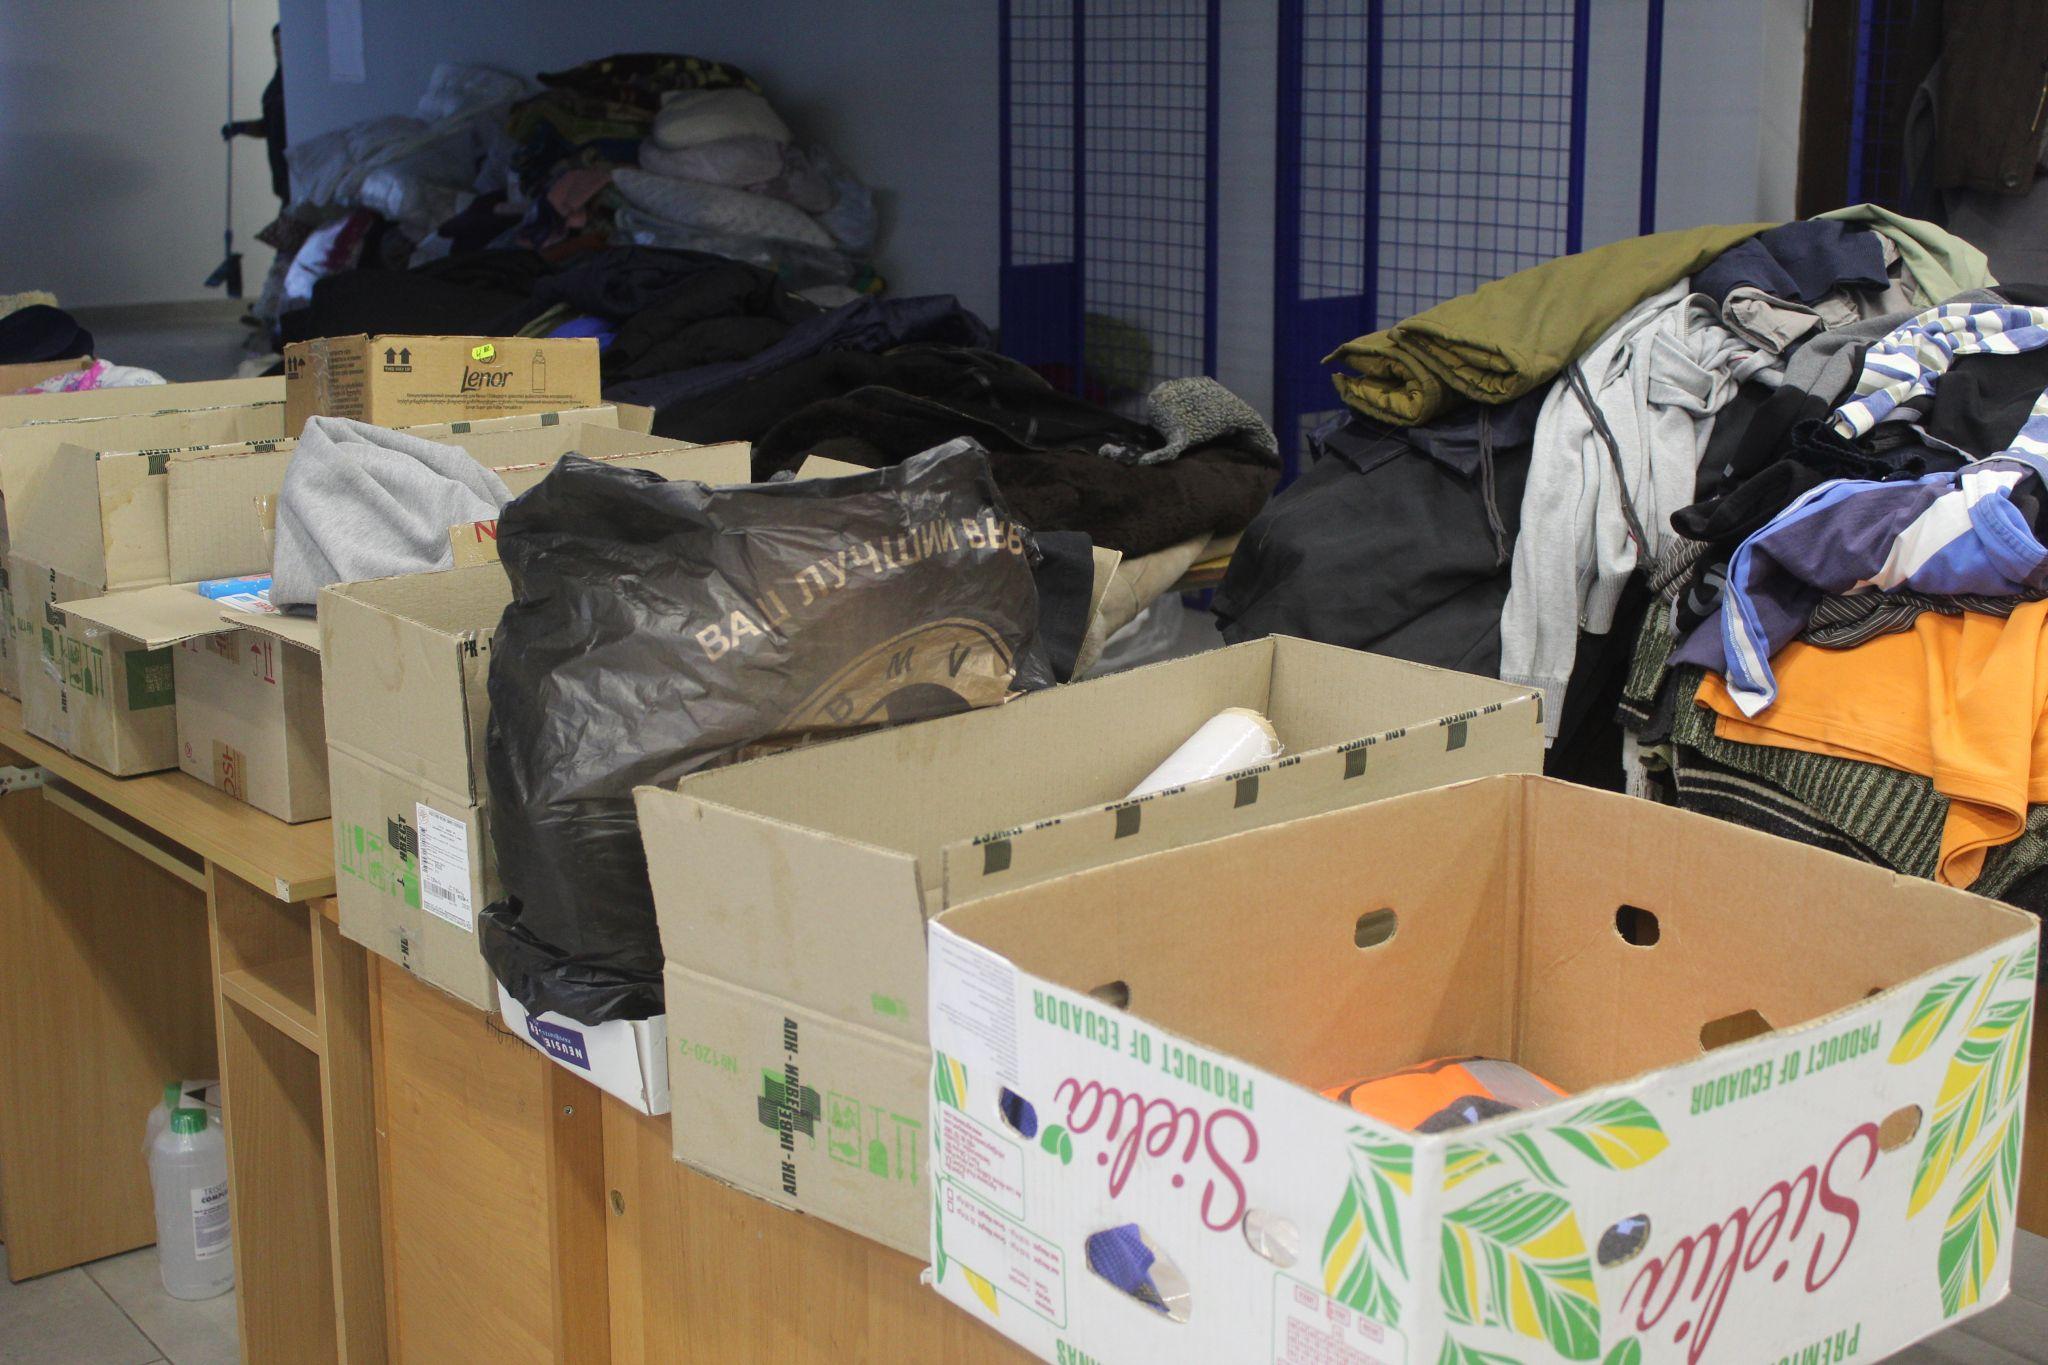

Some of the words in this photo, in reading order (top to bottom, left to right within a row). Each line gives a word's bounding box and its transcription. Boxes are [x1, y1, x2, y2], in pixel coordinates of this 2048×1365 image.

[461, 365, 513, 393] Lenor
[796, 510, 960, 606] ЛУЧШИЙ
[1033, 989, 1120, 1050] ECUADOR
[1129, 1029, 1151, 1064] OF
[1803, 1019, 1882, 1075] PRODUCT
[1161, 1043, 1254, 1110] PRODUCT
[1690, 1060, 1773, 1115] ECUADOR
[1778, 1050, 1801, 1085] OF
[1054, 1077, 1260, 1232] Sielia
[1620, 1122, 1879, 1365] Sielia
